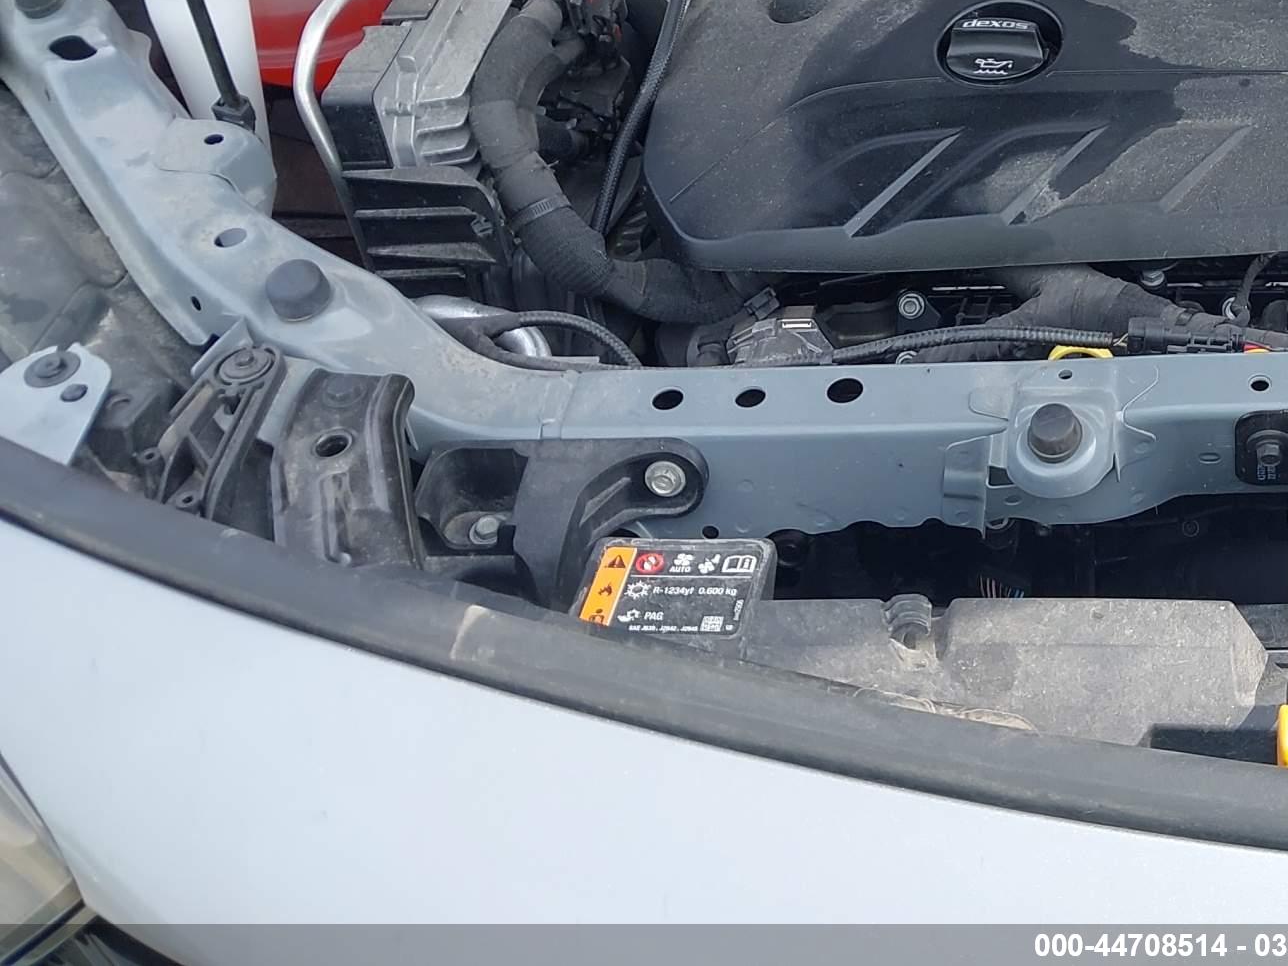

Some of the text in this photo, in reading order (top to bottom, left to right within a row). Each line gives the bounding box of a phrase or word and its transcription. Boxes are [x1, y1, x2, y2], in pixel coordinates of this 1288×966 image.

[962, 19, 1029, 30] dexos
[652, 586, 738, 596] R-1234yf 0.600 kg
[643, 611, 664, 621] PAG
